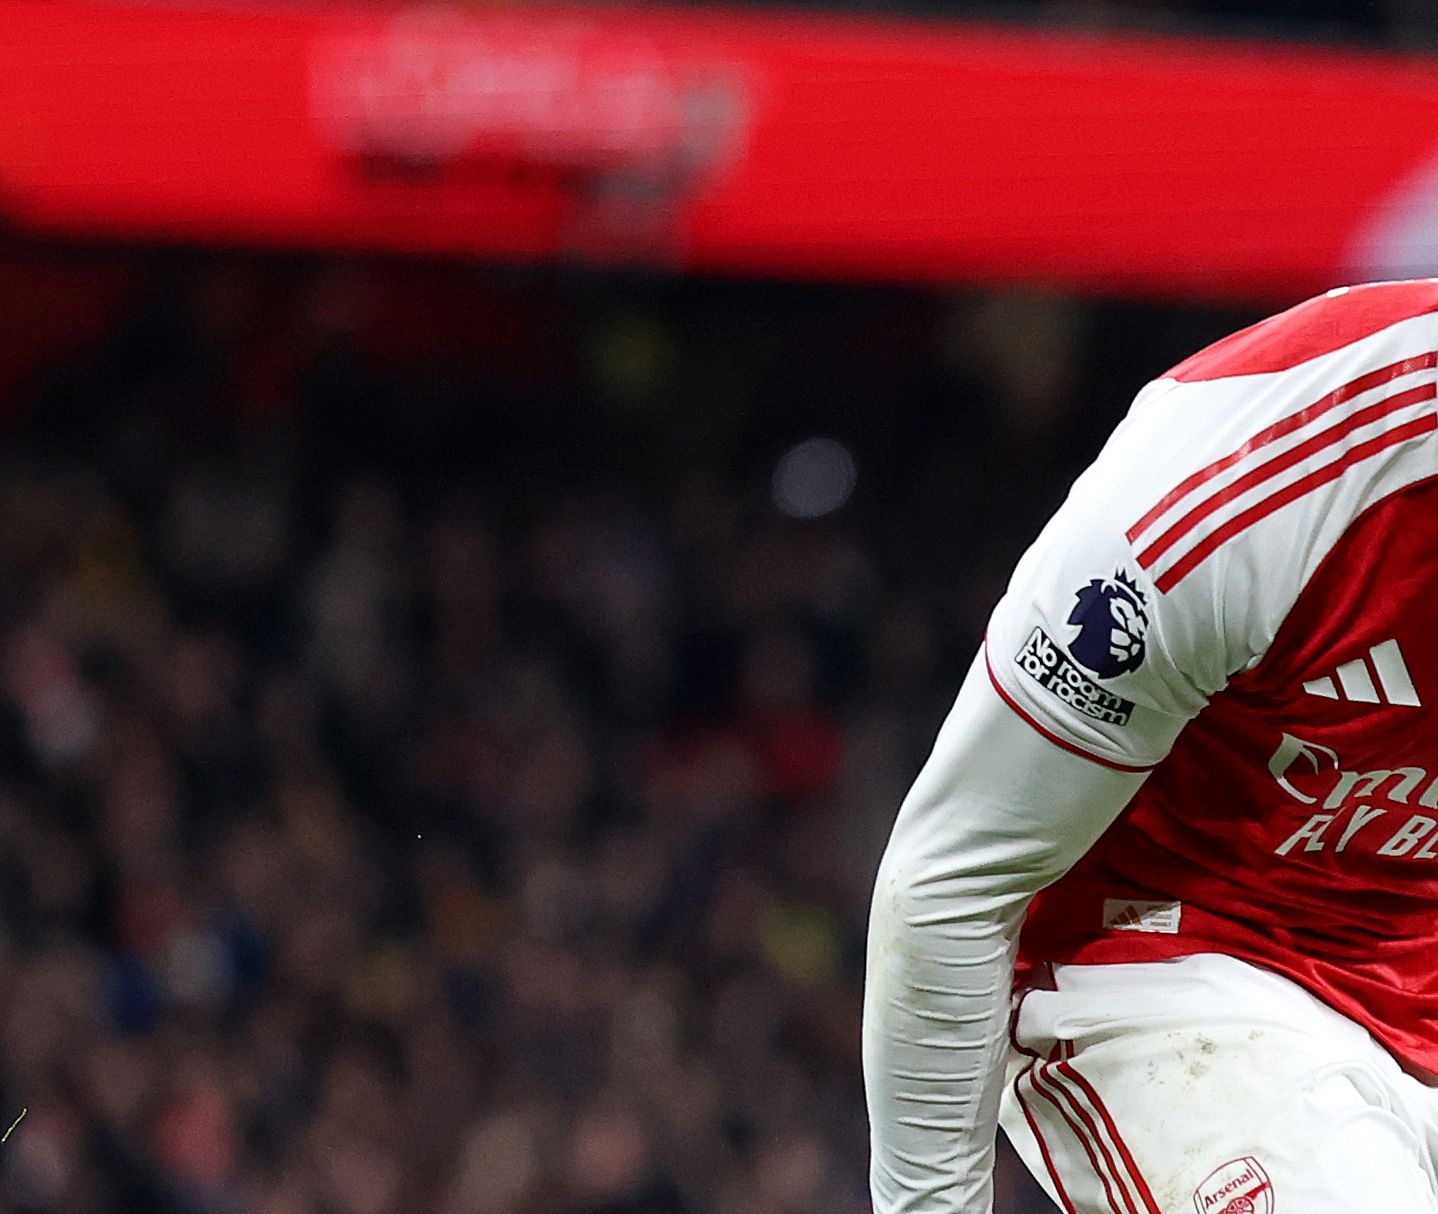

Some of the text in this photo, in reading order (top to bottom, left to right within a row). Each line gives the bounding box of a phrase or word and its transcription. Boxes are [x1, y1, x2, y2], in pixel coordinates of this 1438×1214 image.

[1026, 627, 1122, 709] No room
[1047, 676, 1128, 725] racism
[1274, 805, 1387, 856] FLY
[1204, 1168, 1255, 1210] Arsenal
